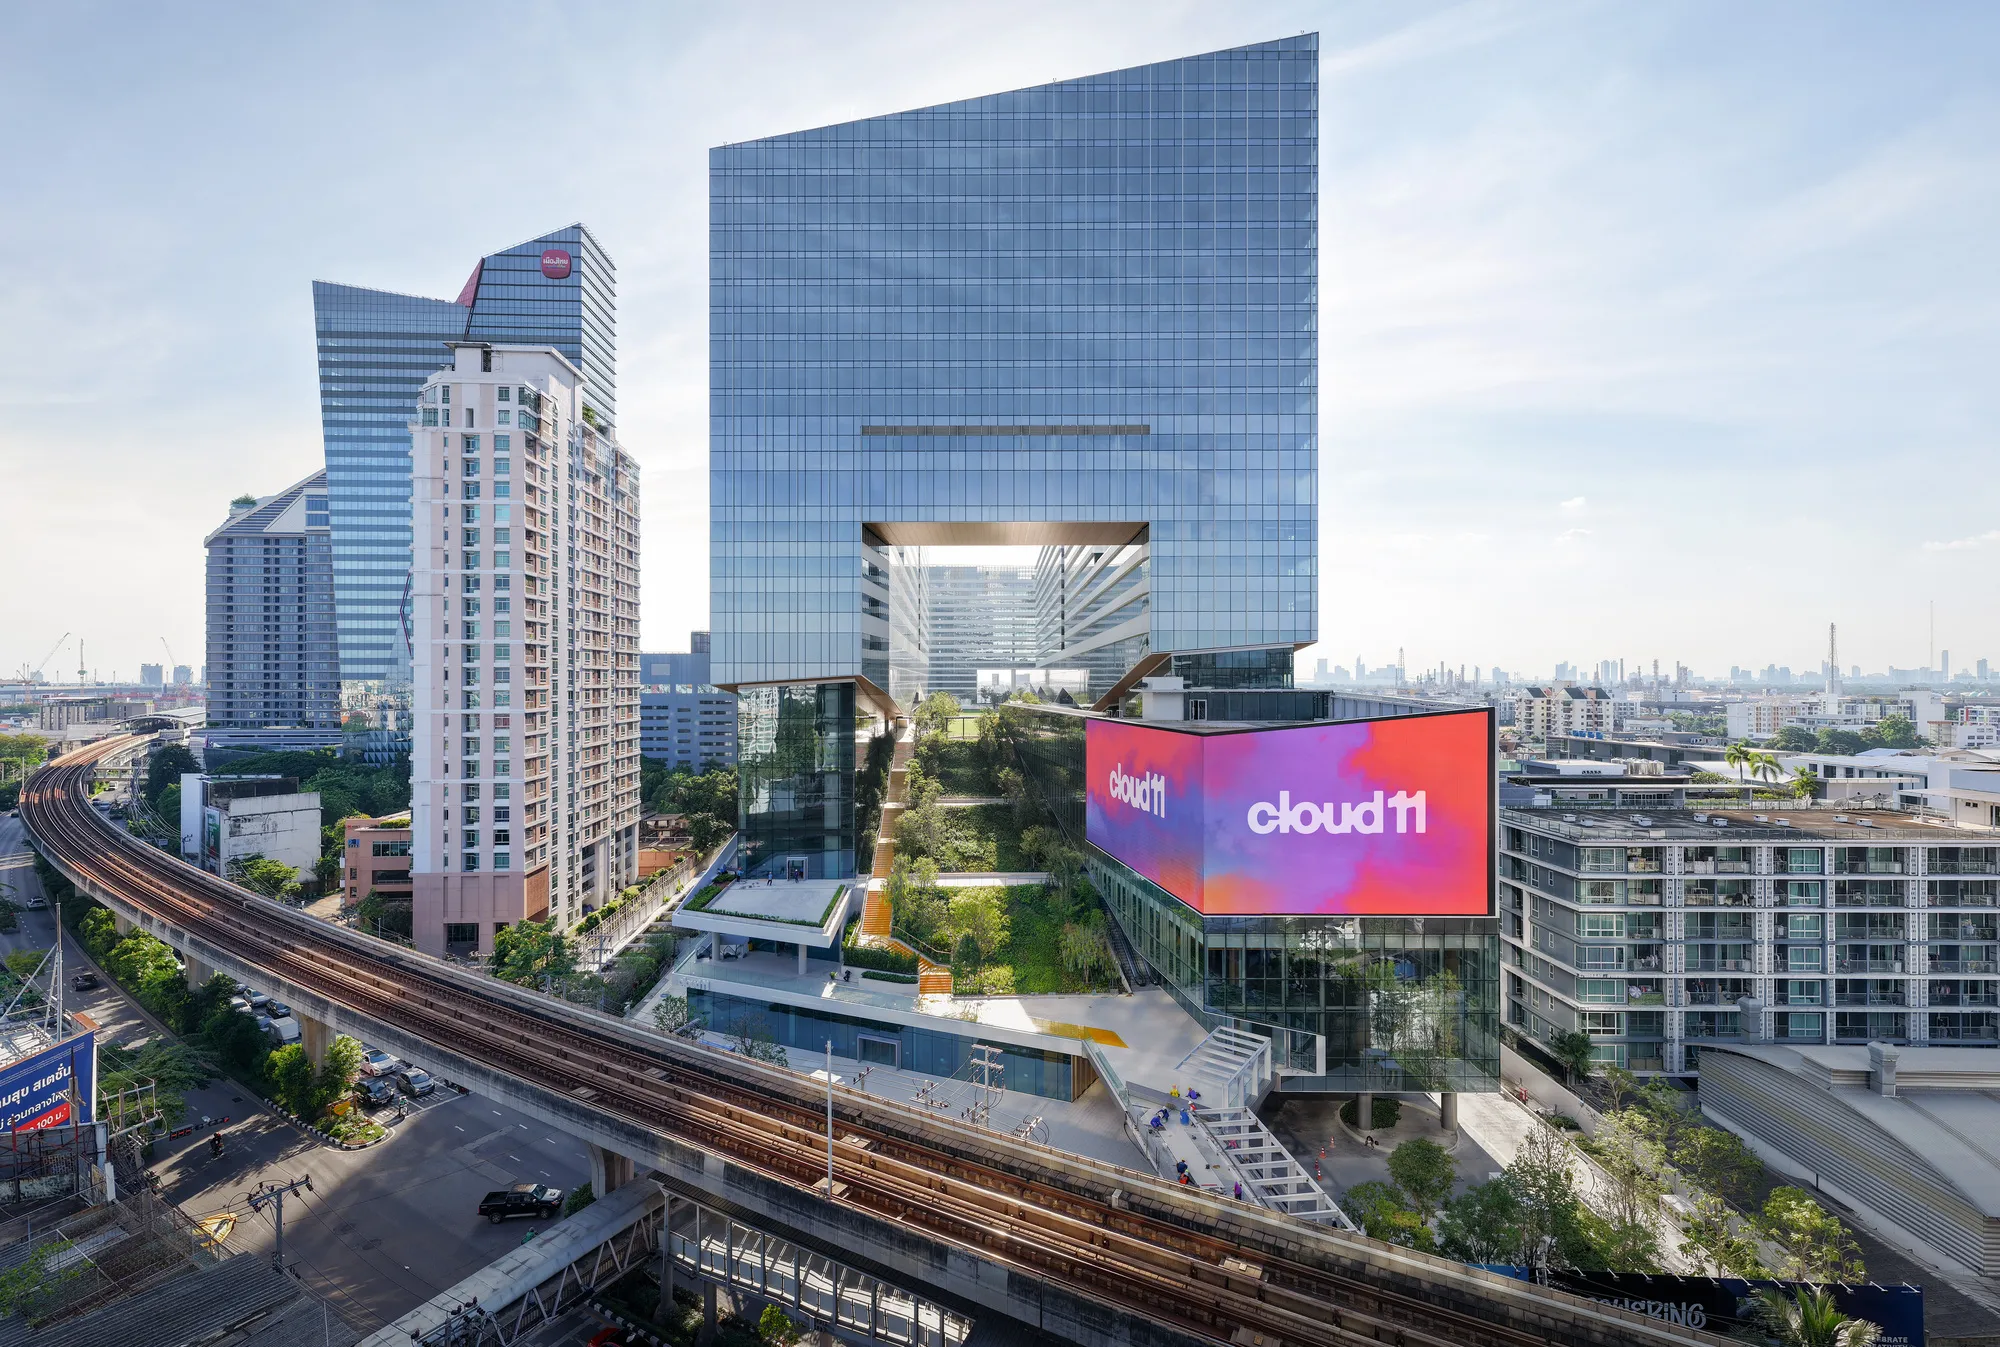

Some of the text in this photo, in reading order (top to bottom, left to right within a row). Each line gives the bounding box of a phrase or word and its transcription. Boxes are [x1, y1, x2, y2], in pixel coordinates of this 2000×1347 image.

[1109, 763, 1166, 818] cloud11
[1247, 790, 1427, 834] cloud11
[37, 1115, 54, 1129] 100
